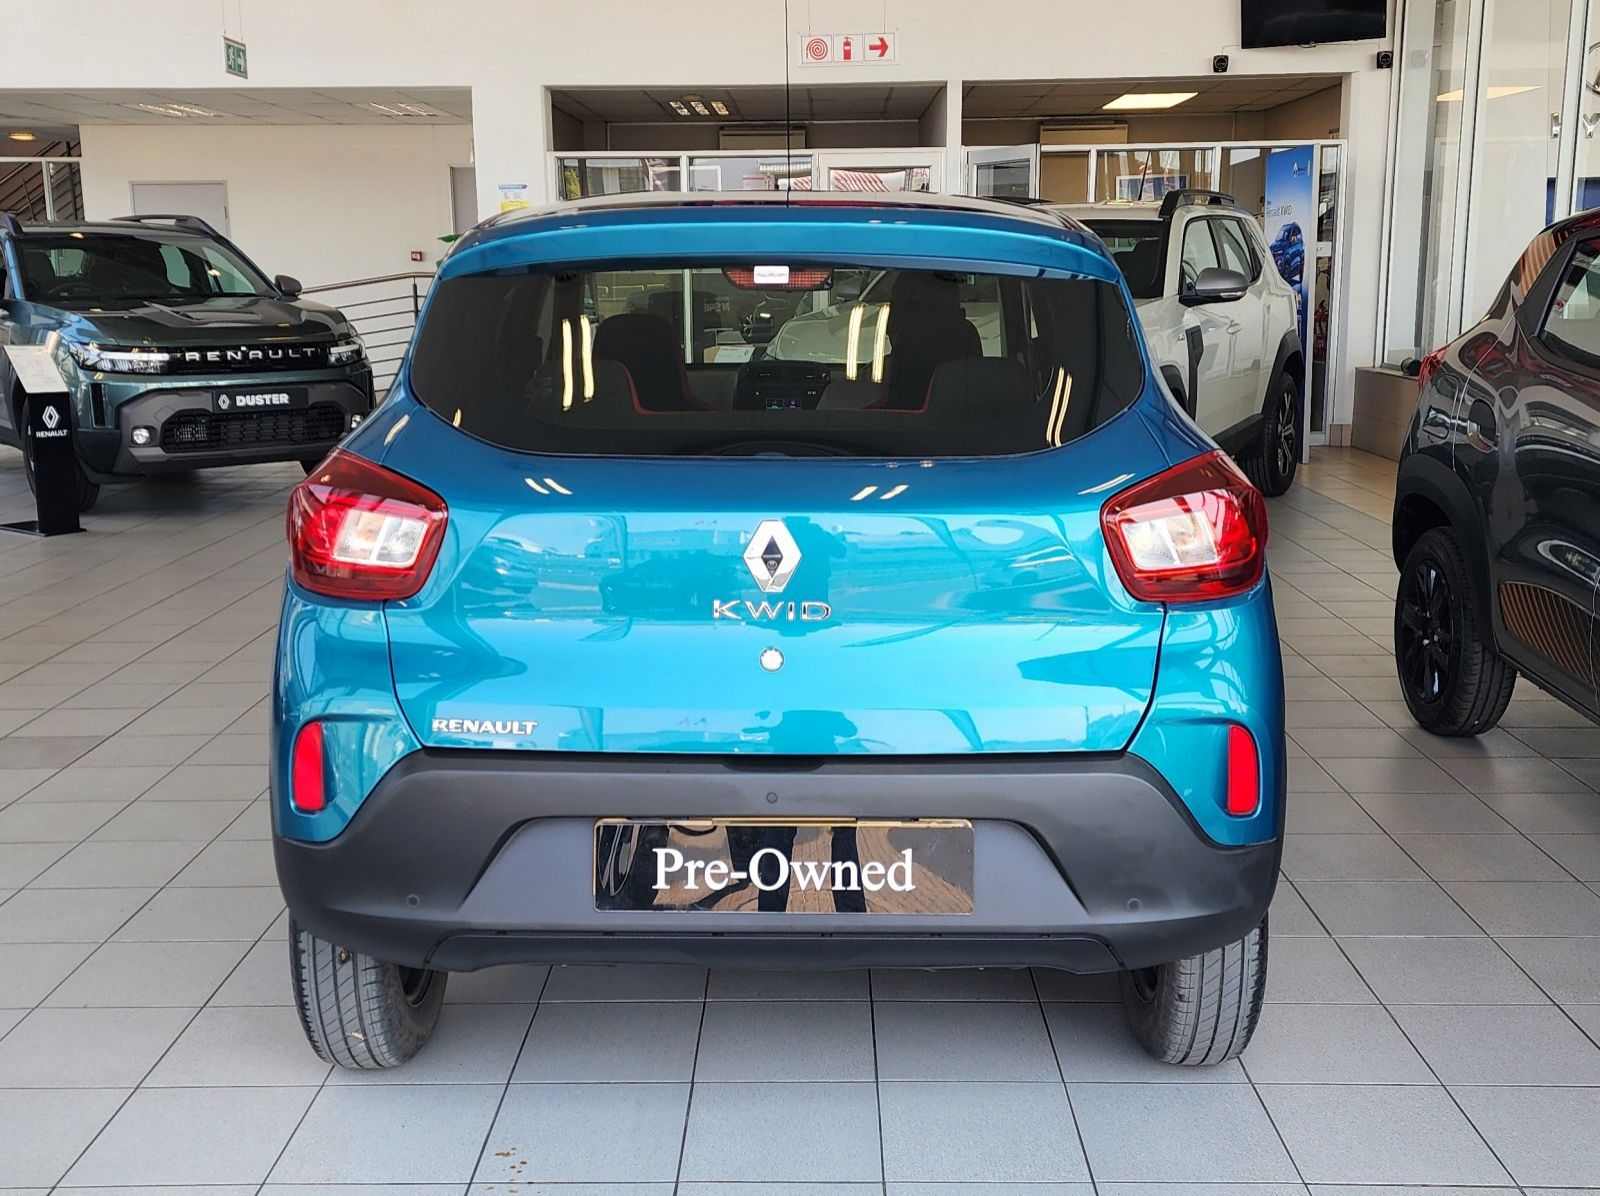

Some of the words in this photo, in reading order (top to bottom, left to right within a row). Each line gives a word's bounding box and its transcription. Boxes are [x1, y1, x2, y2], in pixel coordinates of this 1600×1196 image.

[185, 348, 315, 361] RENAULT
[235, 393, 289, 406] DUSTER
[35, 429, 68, 438] RENAULT
[713, 599, 831, 620] KWID
[432, 718, 538, 735] RENAULT
[651, 847, 917, 892] Pre-Owned
